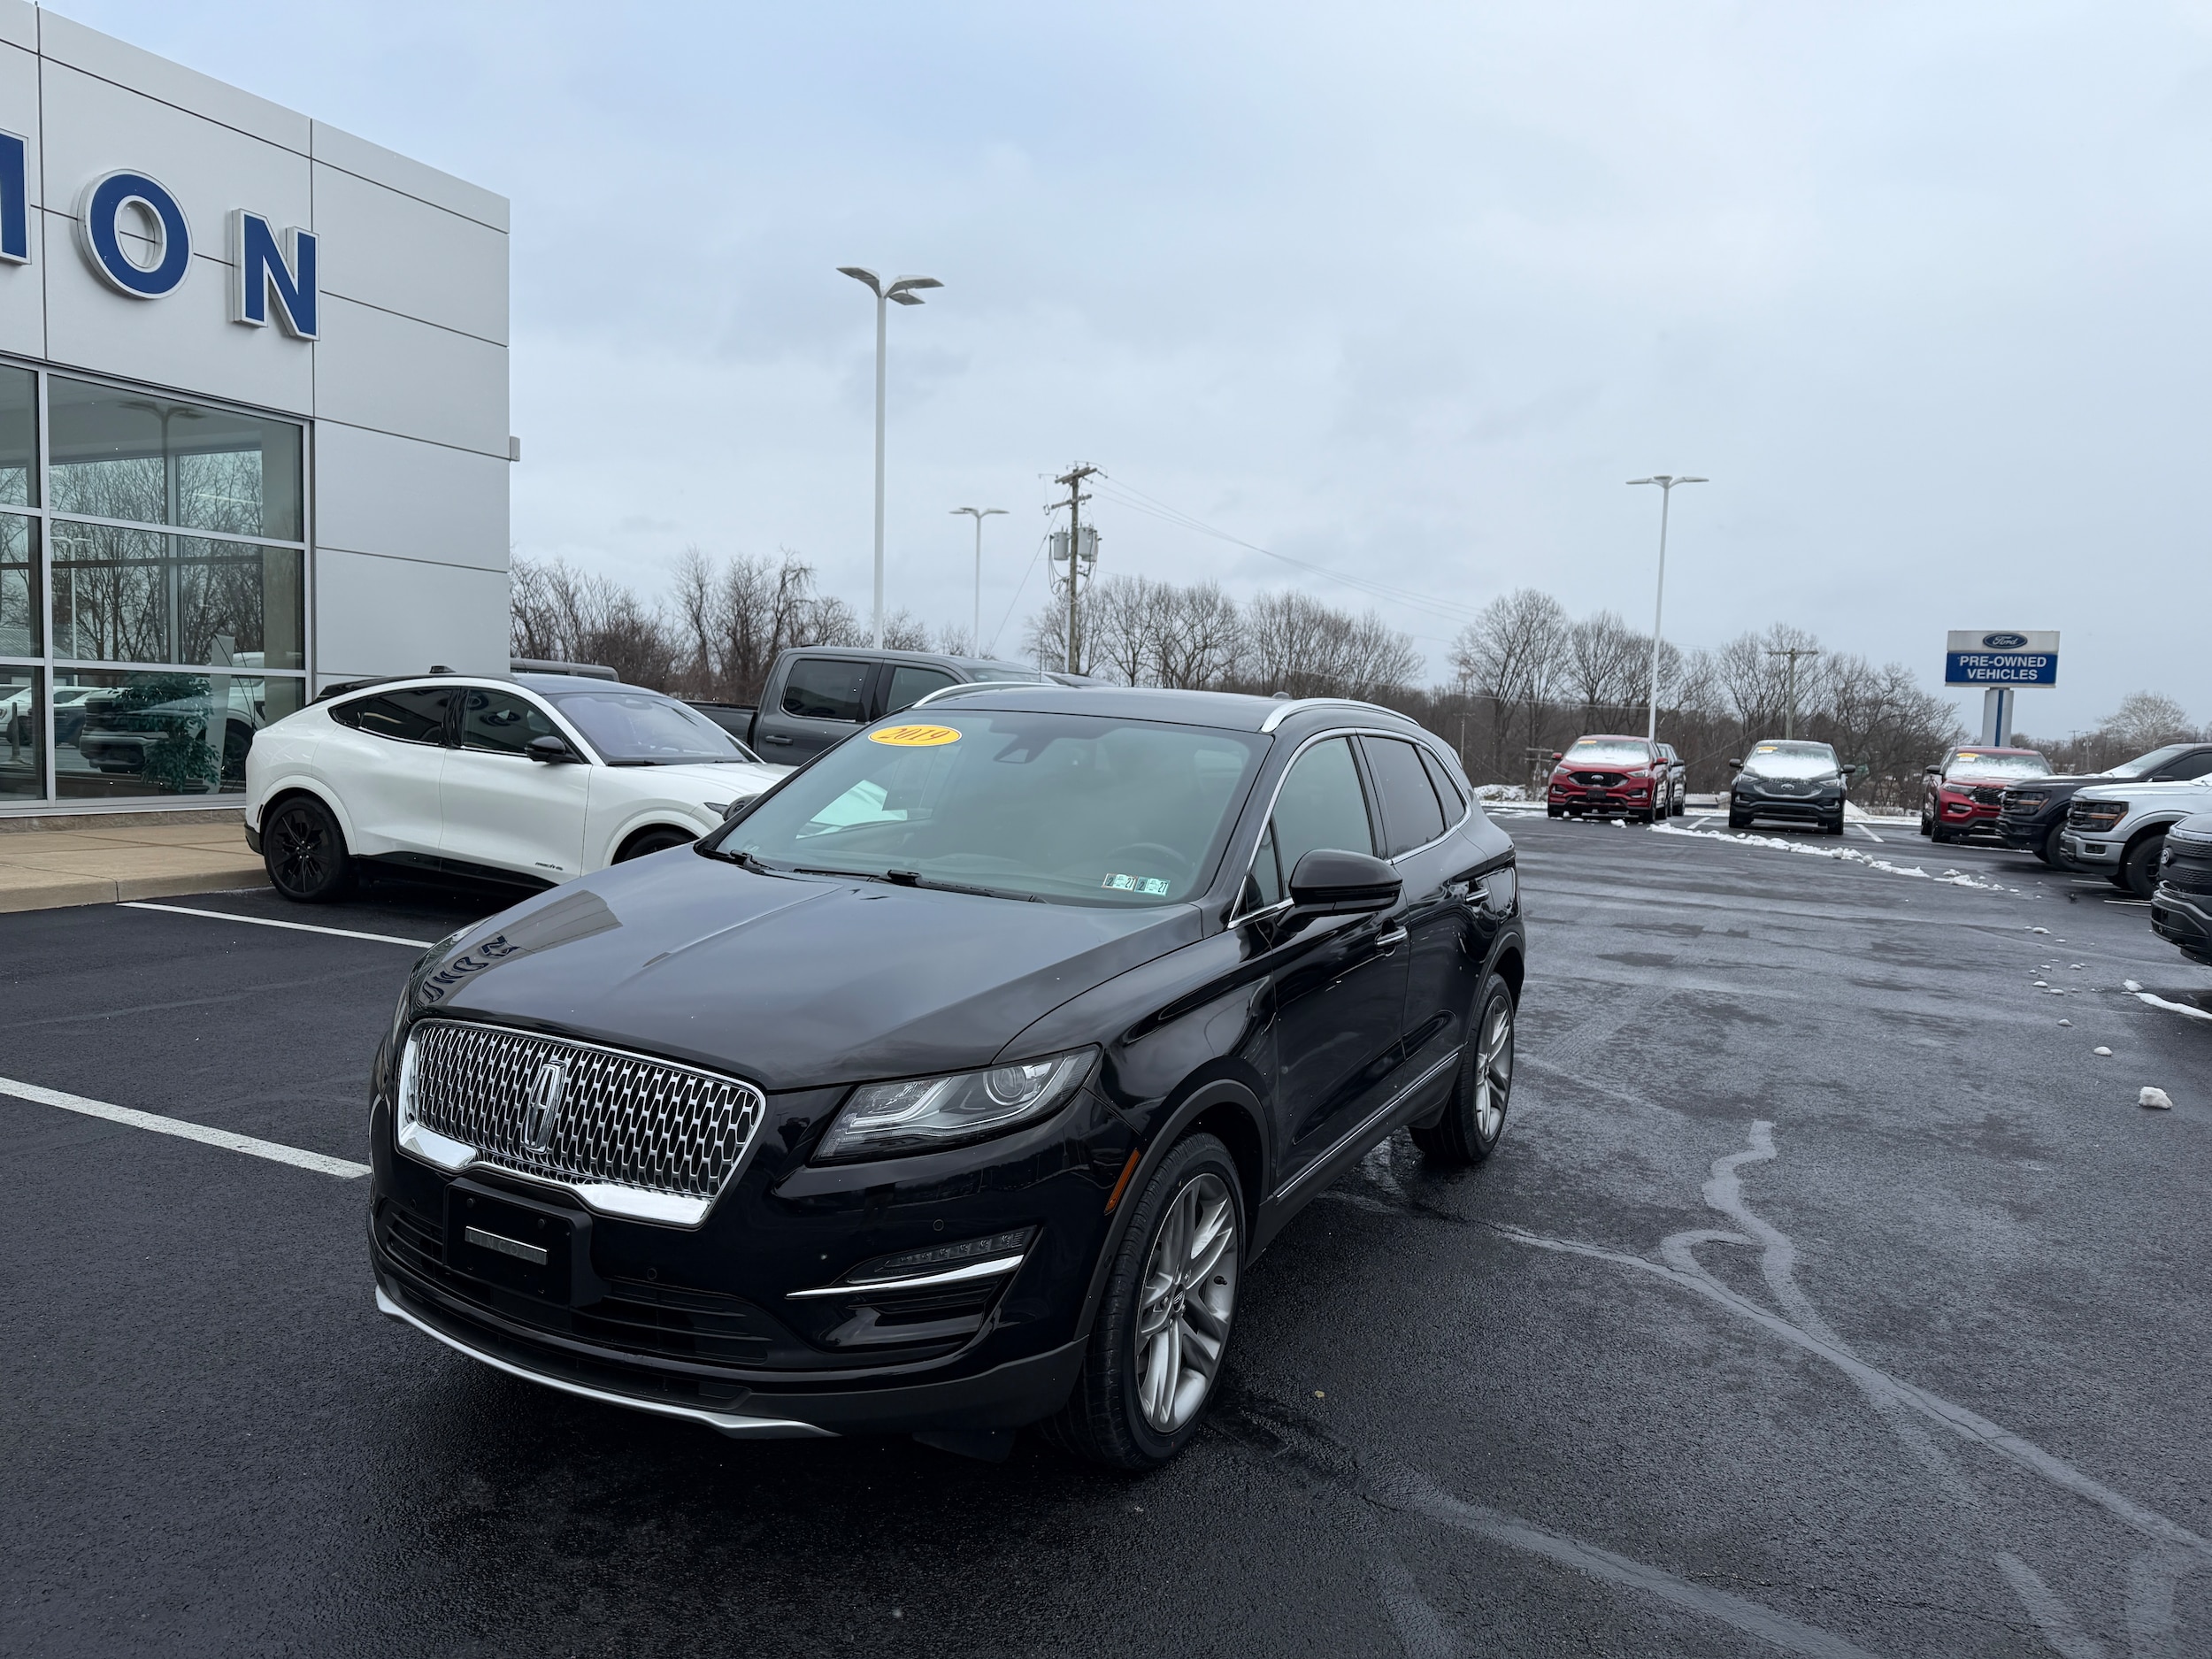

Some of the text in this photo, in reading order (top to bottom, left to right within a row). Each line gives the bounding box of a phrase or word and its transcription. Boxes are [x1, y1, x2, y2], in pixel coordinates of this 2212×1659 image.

[1992, 635, 2018, 646] Ford
[1959, 656, 2047, 667] PRE-OWNED
[1967, 668, 2038, 680] VEHICLES
[877, 727, 950, 741] 2019
[1107, 877, 1114, 887] 2
[1125, 878, 1134, 888] 27
[1138, 881, 1145, 890] 2
[1158, 882, 1167, 893] 27
